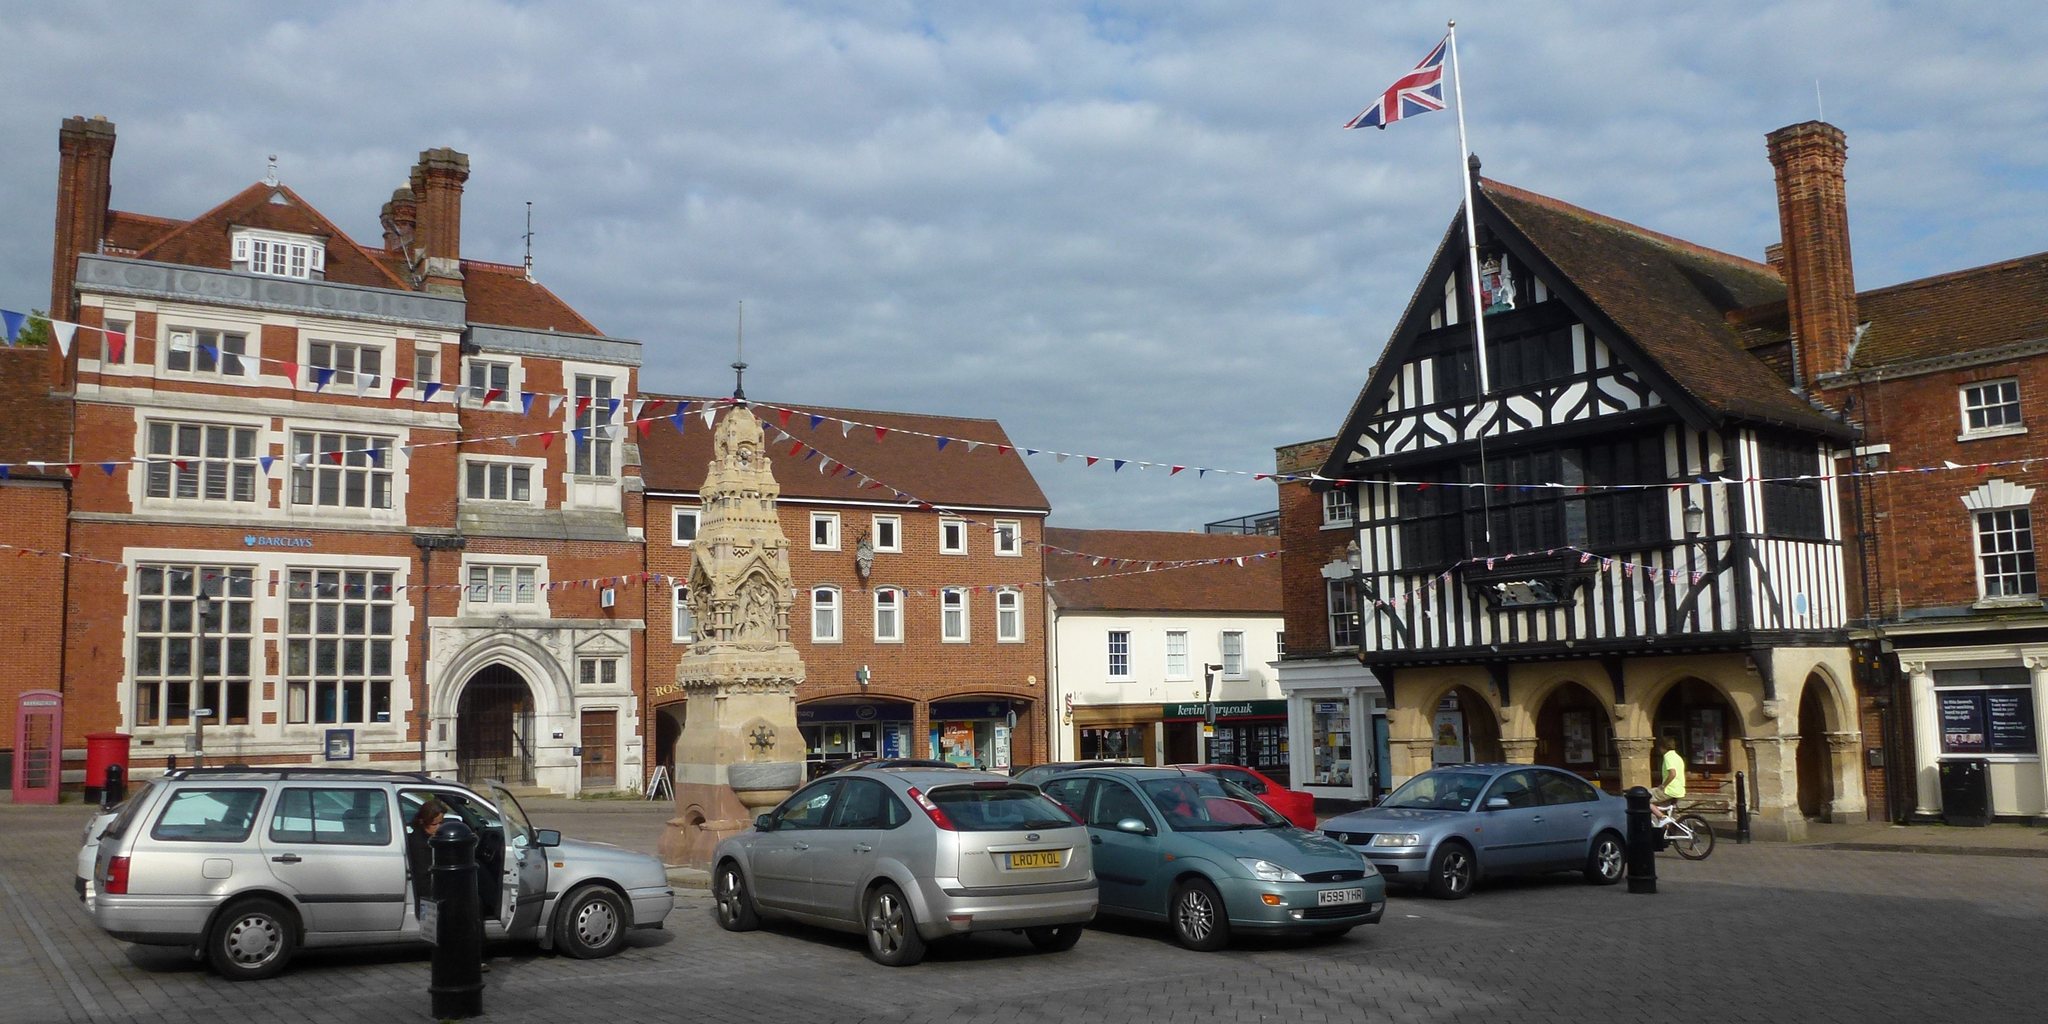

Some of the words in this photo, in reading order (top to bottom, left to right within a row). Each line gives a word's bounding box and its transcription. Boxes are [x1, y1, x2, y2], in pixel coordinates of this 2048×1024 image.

[258, 536, 313, 547] BARCLAYS
[1013, 854, 1038, 866] LR07
[1320, 891, 1344, 903] W599
[1346, 889, 1362, 900] YHR
